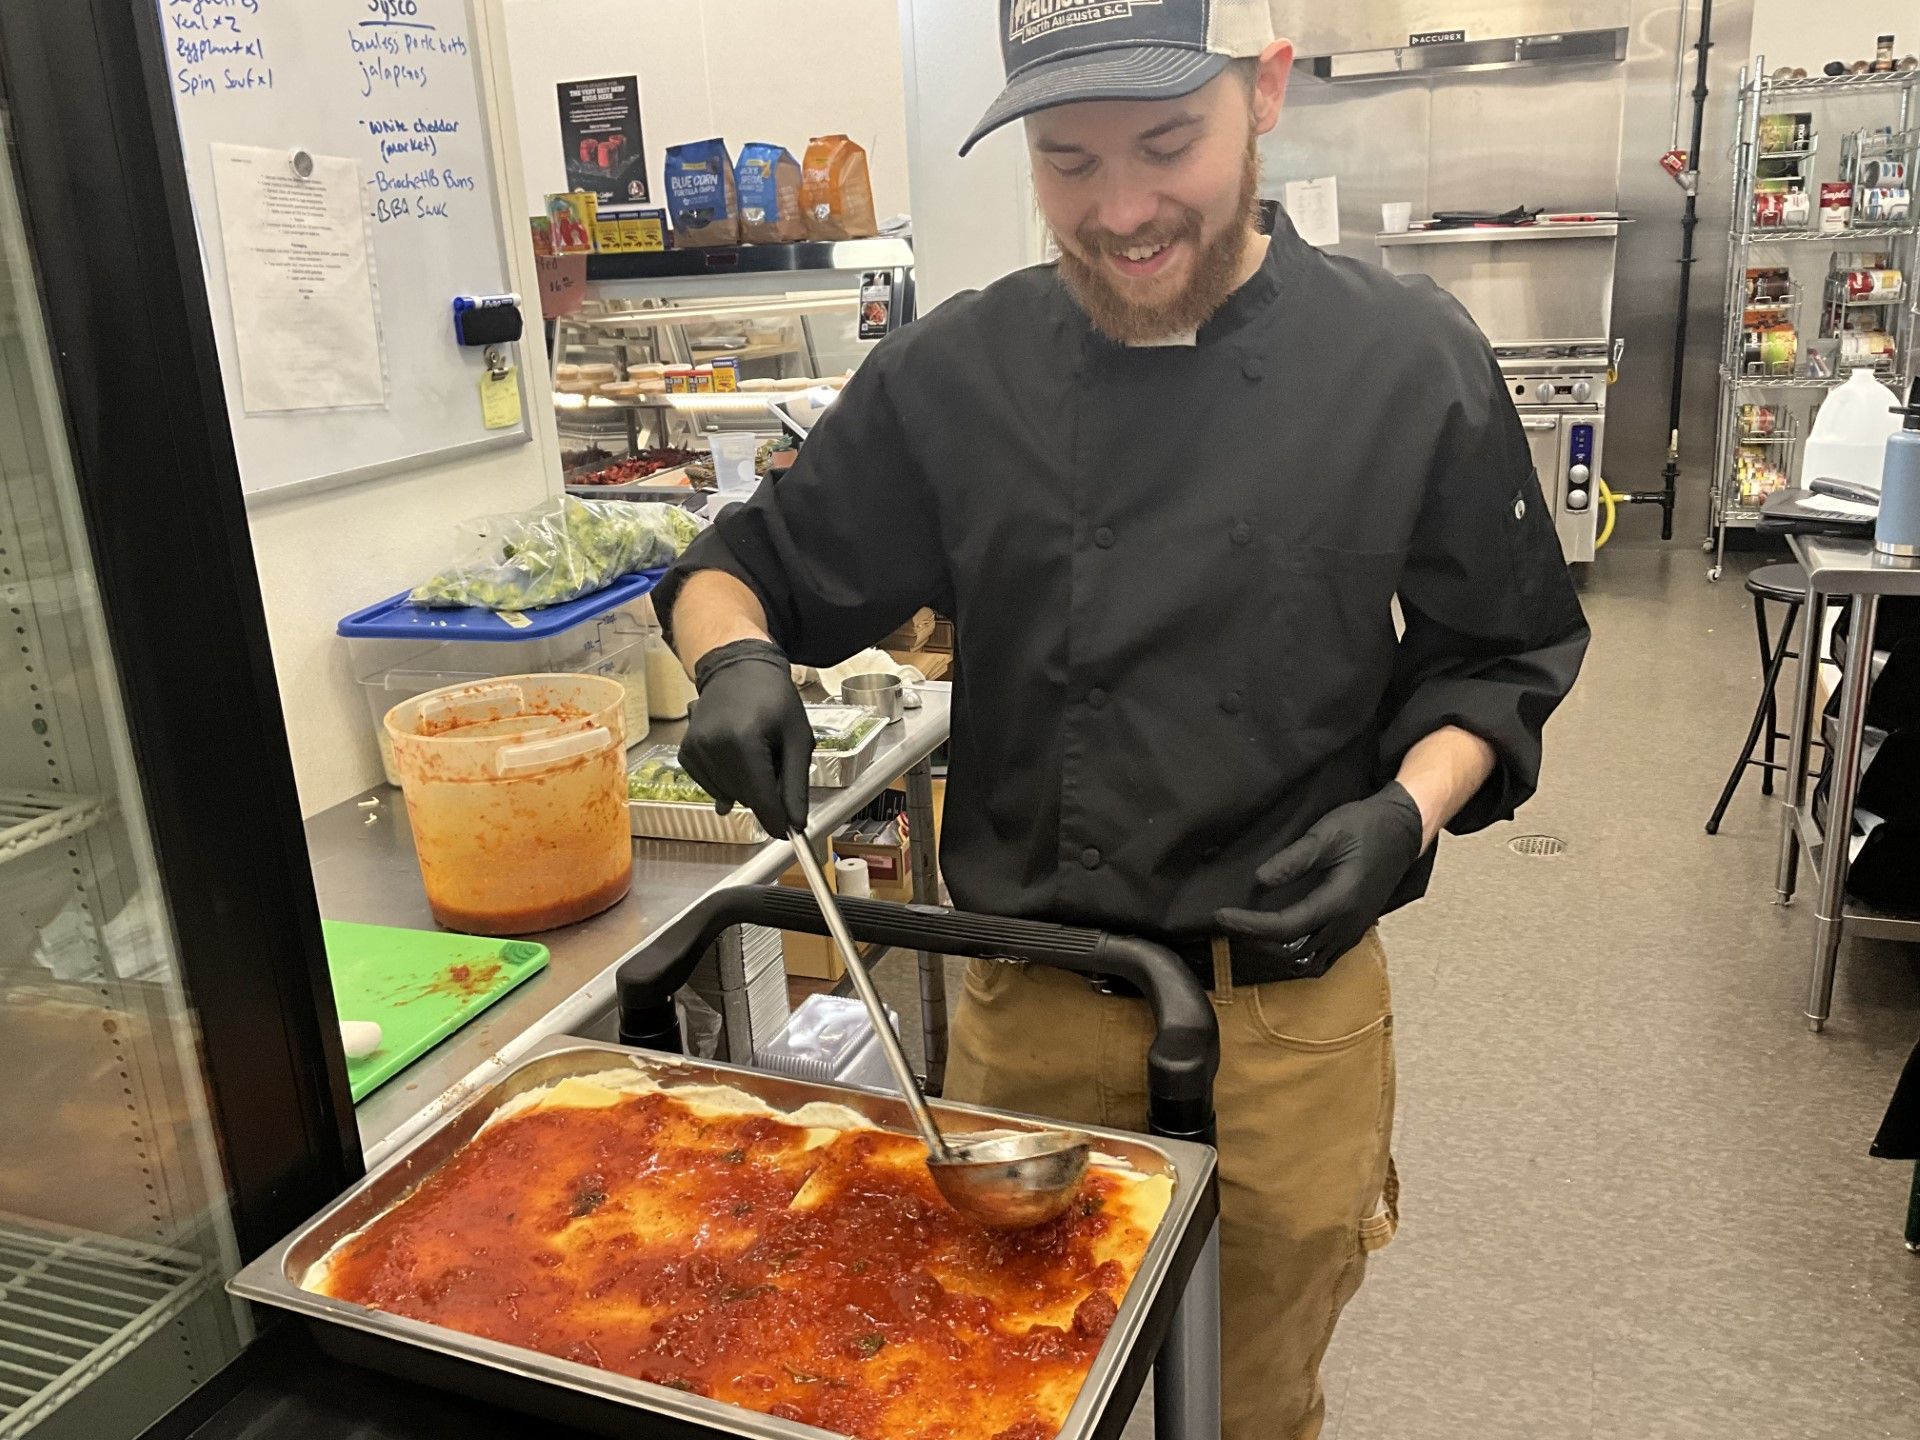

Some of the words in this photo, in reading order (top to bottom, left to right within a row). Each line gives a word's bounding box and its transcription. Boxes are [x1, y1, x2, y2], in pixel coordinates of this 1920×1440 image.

[1025, 19, 1050, 37] North
[1052, 8, 1101, 28] Augusta
[1104, 4, 1127, 16] S.C.
[1419, 33, 1462, 43] ACCUREX
[178, 68, 216, 96] Spin
[671, 175, 693, 190] BLUE
[693, 174, 718, 186] CORN
